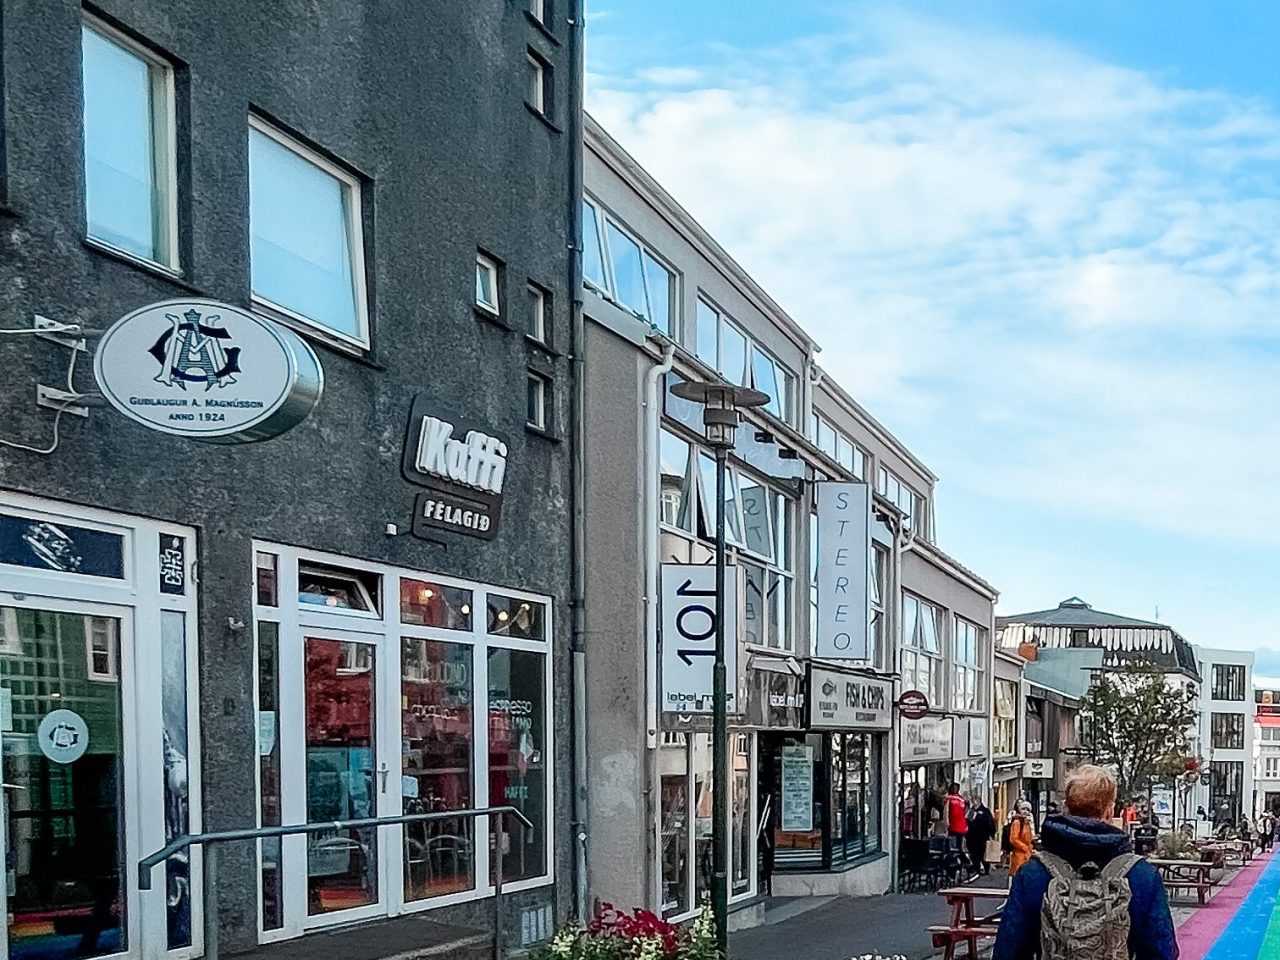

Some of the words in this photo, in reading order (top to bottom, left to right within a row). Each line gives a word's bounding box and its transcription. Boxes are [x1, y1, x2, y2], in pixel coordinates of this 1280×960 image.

[168, 412, 195, 422] ANNO
[198, 412, 226, 422] 1924
[191, 398, 202, 408] A.
[415, 415, 508, 495] Kaffi
[676, 578, 718, 667] 101
[845, 681, 861, 709] FISH
